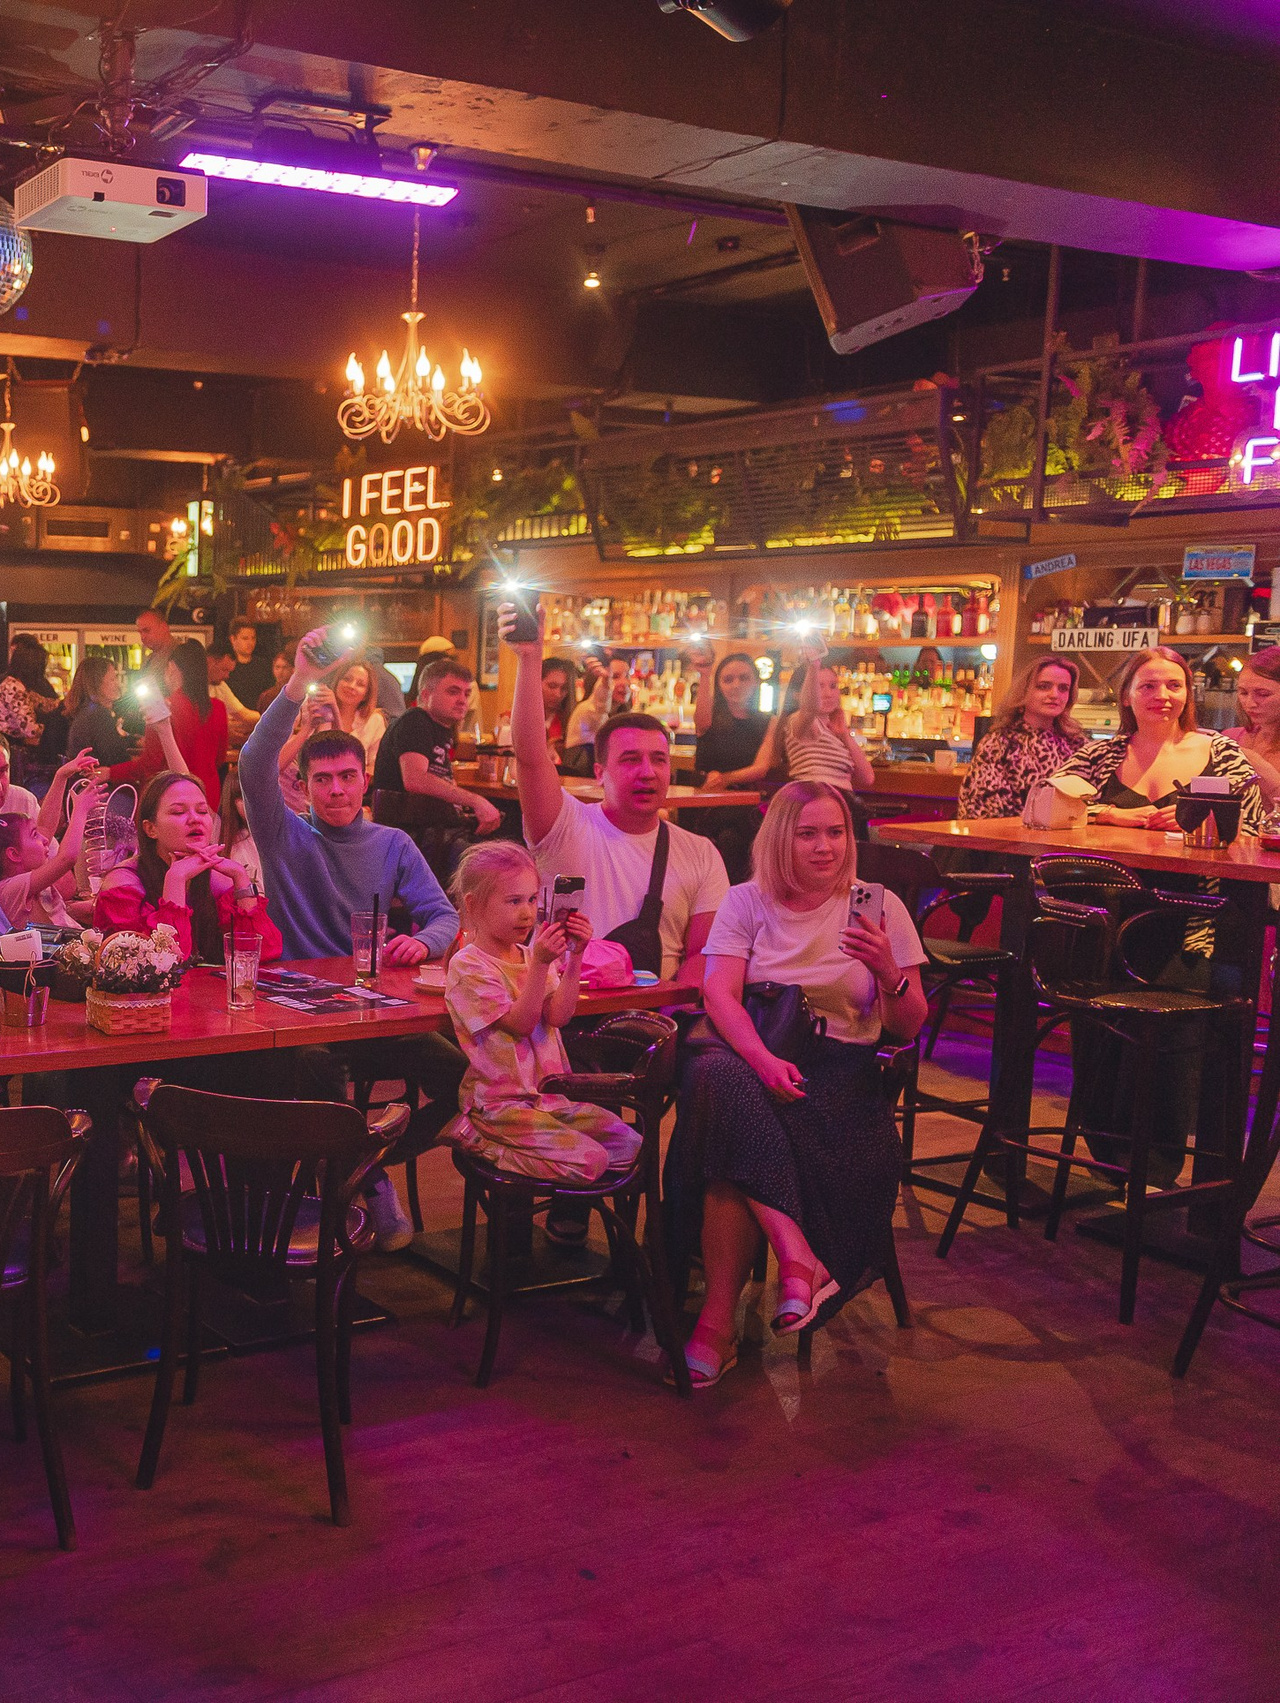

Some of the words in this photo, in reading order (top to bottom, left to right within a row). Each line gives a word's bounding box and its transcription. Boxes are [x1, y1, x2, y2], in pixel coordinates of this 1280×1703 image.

[343, 478, 352, 519] I
[360, 466, 448, 517] FEEL
[346, 517, 440, 566] GOOD
[1035, 556, 1074, 575] ANDREA
[100, 634, 127, 642] WINE
[1058, 631, 1115, 648] DARLING
[1122, 631, 1150, 648] UFA
